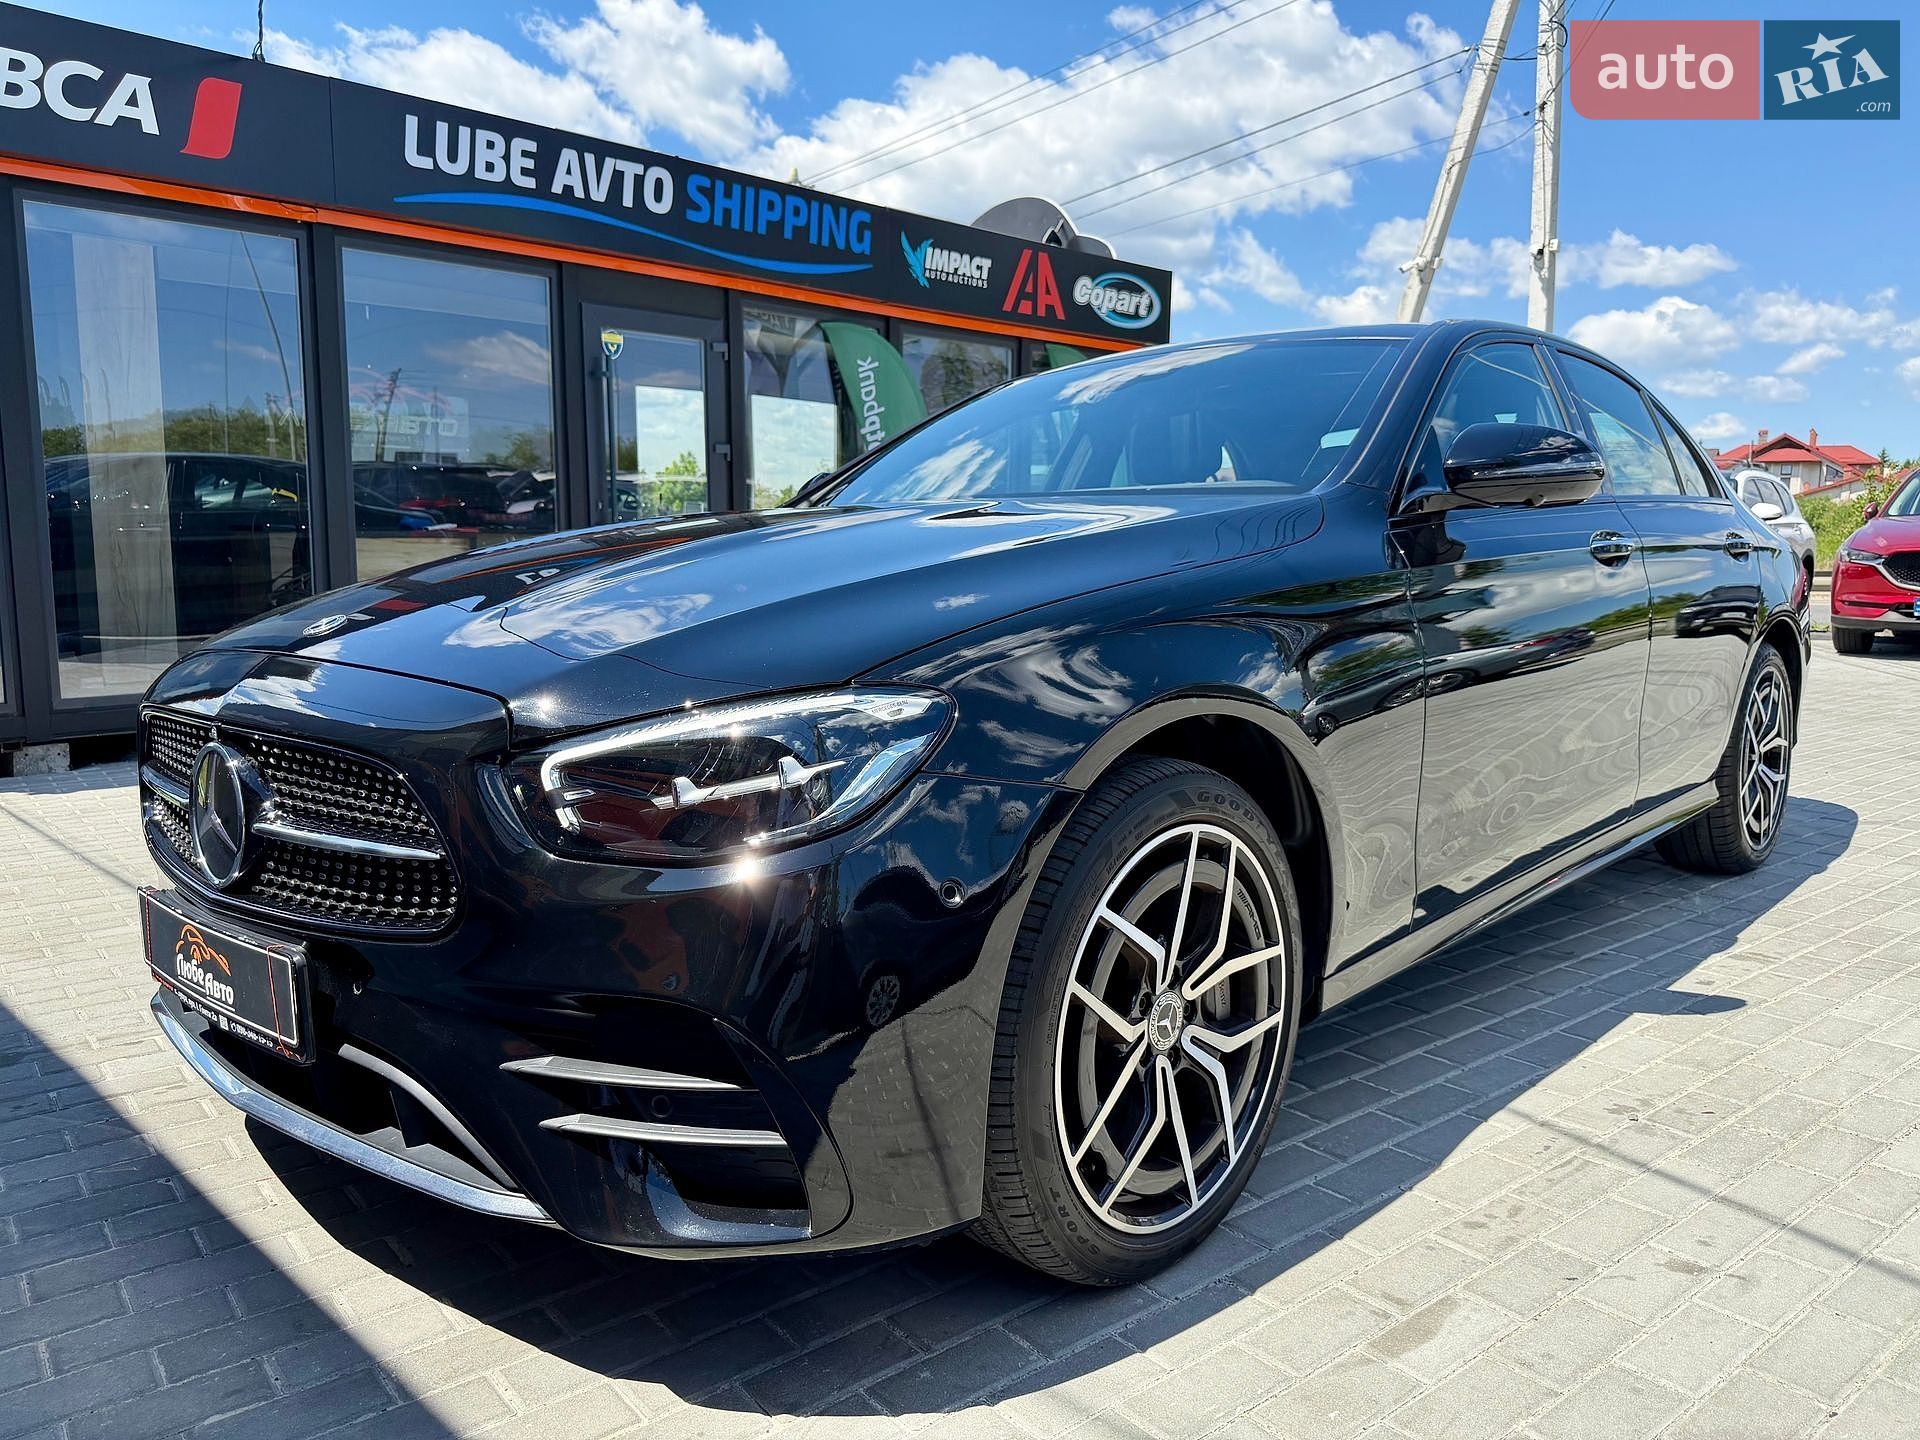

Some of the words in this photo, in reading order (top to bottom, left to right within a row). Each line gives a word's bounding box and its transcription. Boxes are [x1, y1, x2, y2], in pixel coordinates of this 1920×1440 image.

[0, 46, 160, 136] BCA
[404, 113, 539, 190] LUBE
[550, 148, 674, 215] AVTO
[685, 175, 873, 255] SHIPPING
[925, 247, 992, 281] IMPACT
[1073, 275, 1153, 318] Copart
